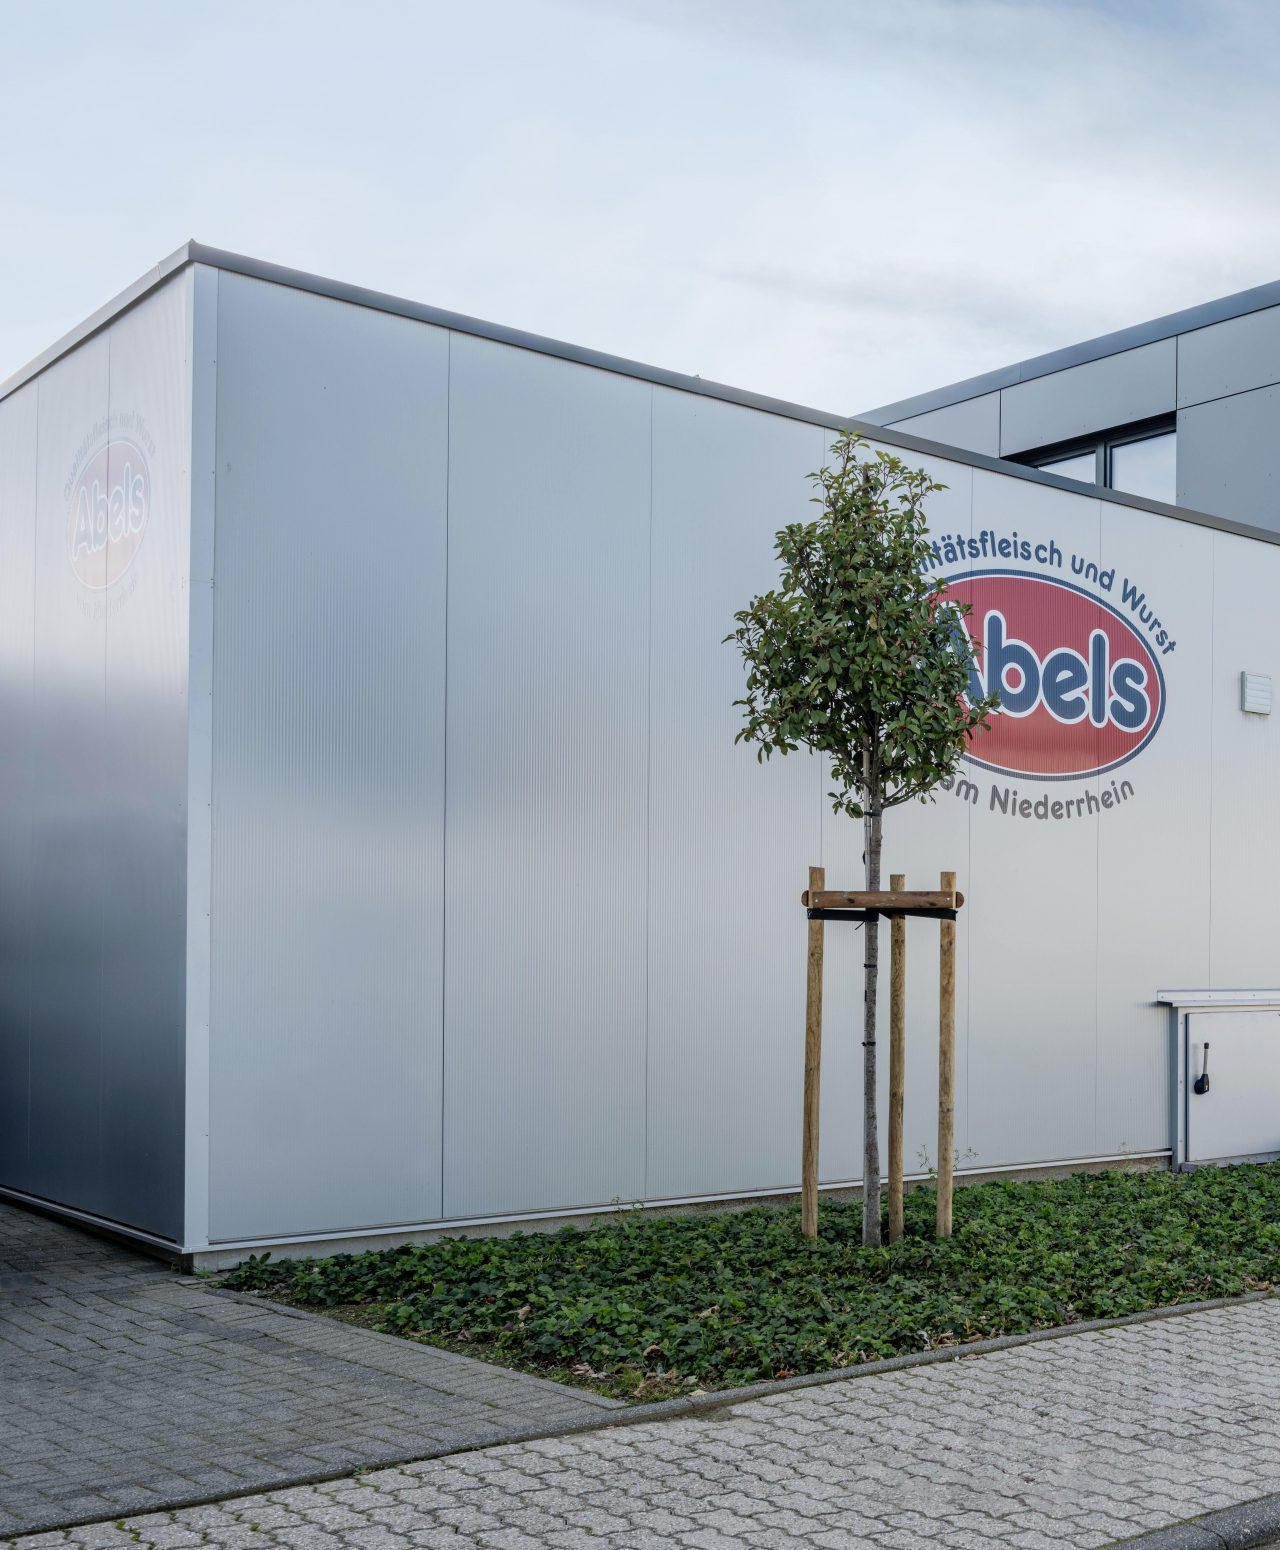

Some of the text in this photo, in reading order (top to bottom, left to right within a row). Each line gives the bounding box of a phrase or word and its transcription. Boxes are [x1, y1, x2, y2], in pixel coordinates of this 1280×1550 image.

[72, 461, 145, 561] Abels
[914, 530, 1177, 655] itätsfleisch und Wurst
[939, 773, 1134, 820] om Niederrhein
